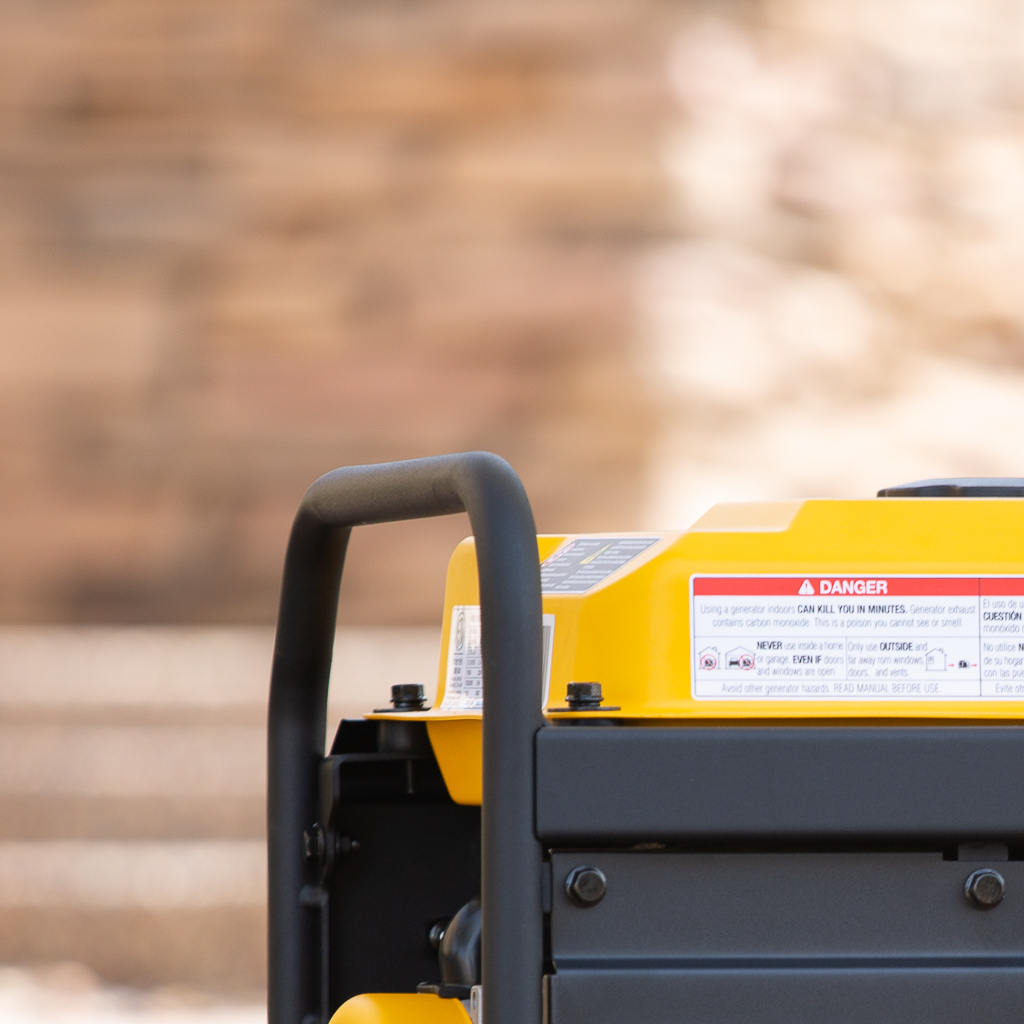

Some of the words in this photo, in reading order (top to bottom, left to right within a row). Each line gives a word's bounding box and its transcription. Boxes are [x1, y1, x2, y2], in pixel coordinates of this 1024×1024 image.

[820, 580, 888, 594] DANGER
[700, 605, 721, 615] Using
[731, 605, 765, 615] generator
[768, 605, 795, 614] indoors
[798, 605, 814, 614] CAN
[818, 605, 835, 614] KILL
[838, 605, 854, 614] YOU
[857, 605, 865, 614] IN
[868, 605, 907, 614] MINUTES.
[910, 605, 945, 614] Generator
[948, 605, 975, 614] exhaust
[983, 610, 1021, 621] CUESTIÓN
[712, 618, 743, 627] contains
[746, 618, 770, 627] carbon
[814, 618, 829, 627] This
[832, 618, 838, 627] is
[847, 618, 871, 629] poison
[874, 620, 887, 629] you
[890, 618, 914, 627] cannot
[757, 642, 782, 650] NEVER
[798, 642, 817, 650] inside
[825, 642, 843, 650] home
[848, 642, 863, 652] Only
[880, 642, 913, 651] OUTSIDE
[915, 642, 928, 651] and
[793, 655, 812, 664] EVEN
[815, 655, 822, 664] IF
[824, 655, 843, 664] doors
[757, 667, 770, 675] and
[772, 667, 802, 675] windows
[834, 684, 854, 693] READ
[857, 684, 889, 693] MANUAL
[892, 684, 921, 693] BEFORE
